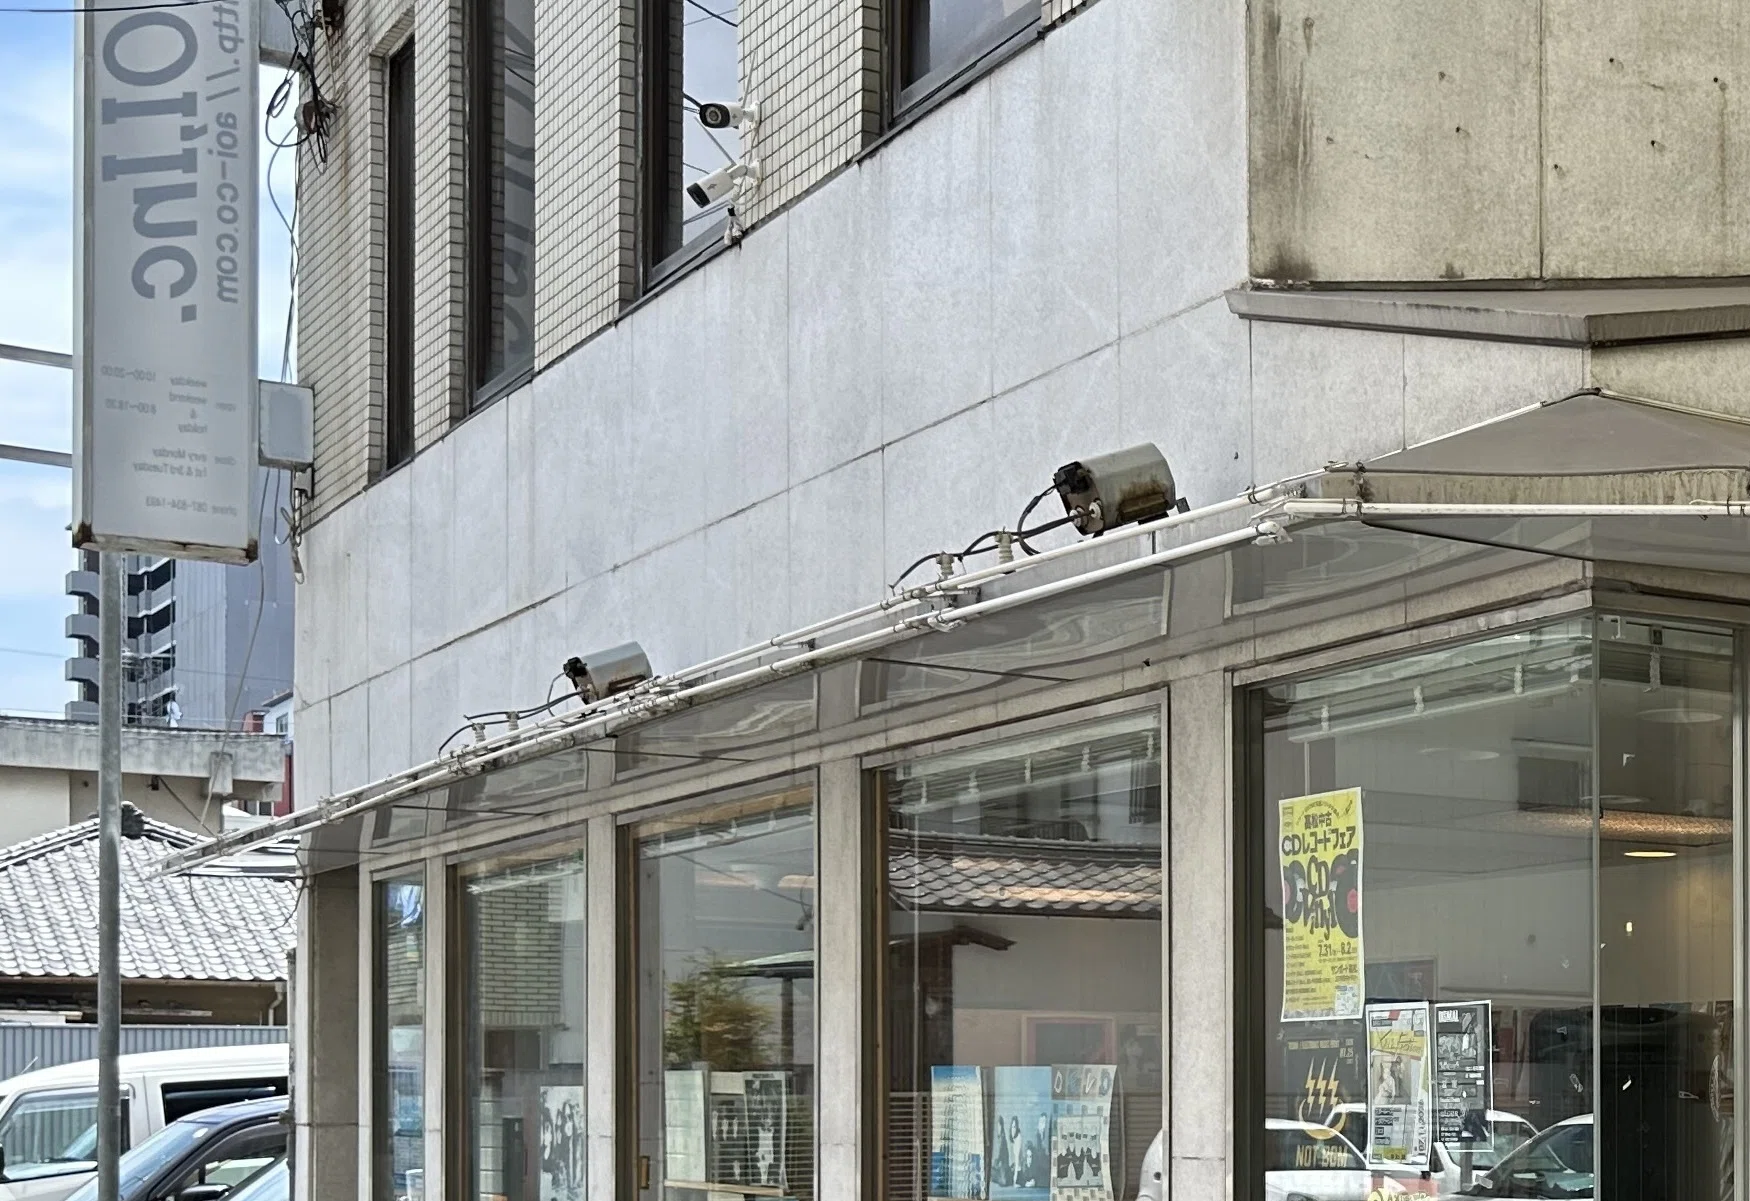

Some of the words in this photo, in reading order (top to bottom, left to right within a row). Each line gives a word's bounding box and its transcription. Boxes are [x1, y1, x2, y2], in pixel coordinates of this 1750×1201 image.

[1282, 826, 1356, 856] CDレコードフェア
[1053, 1067, 1112, 1096] DEVO
